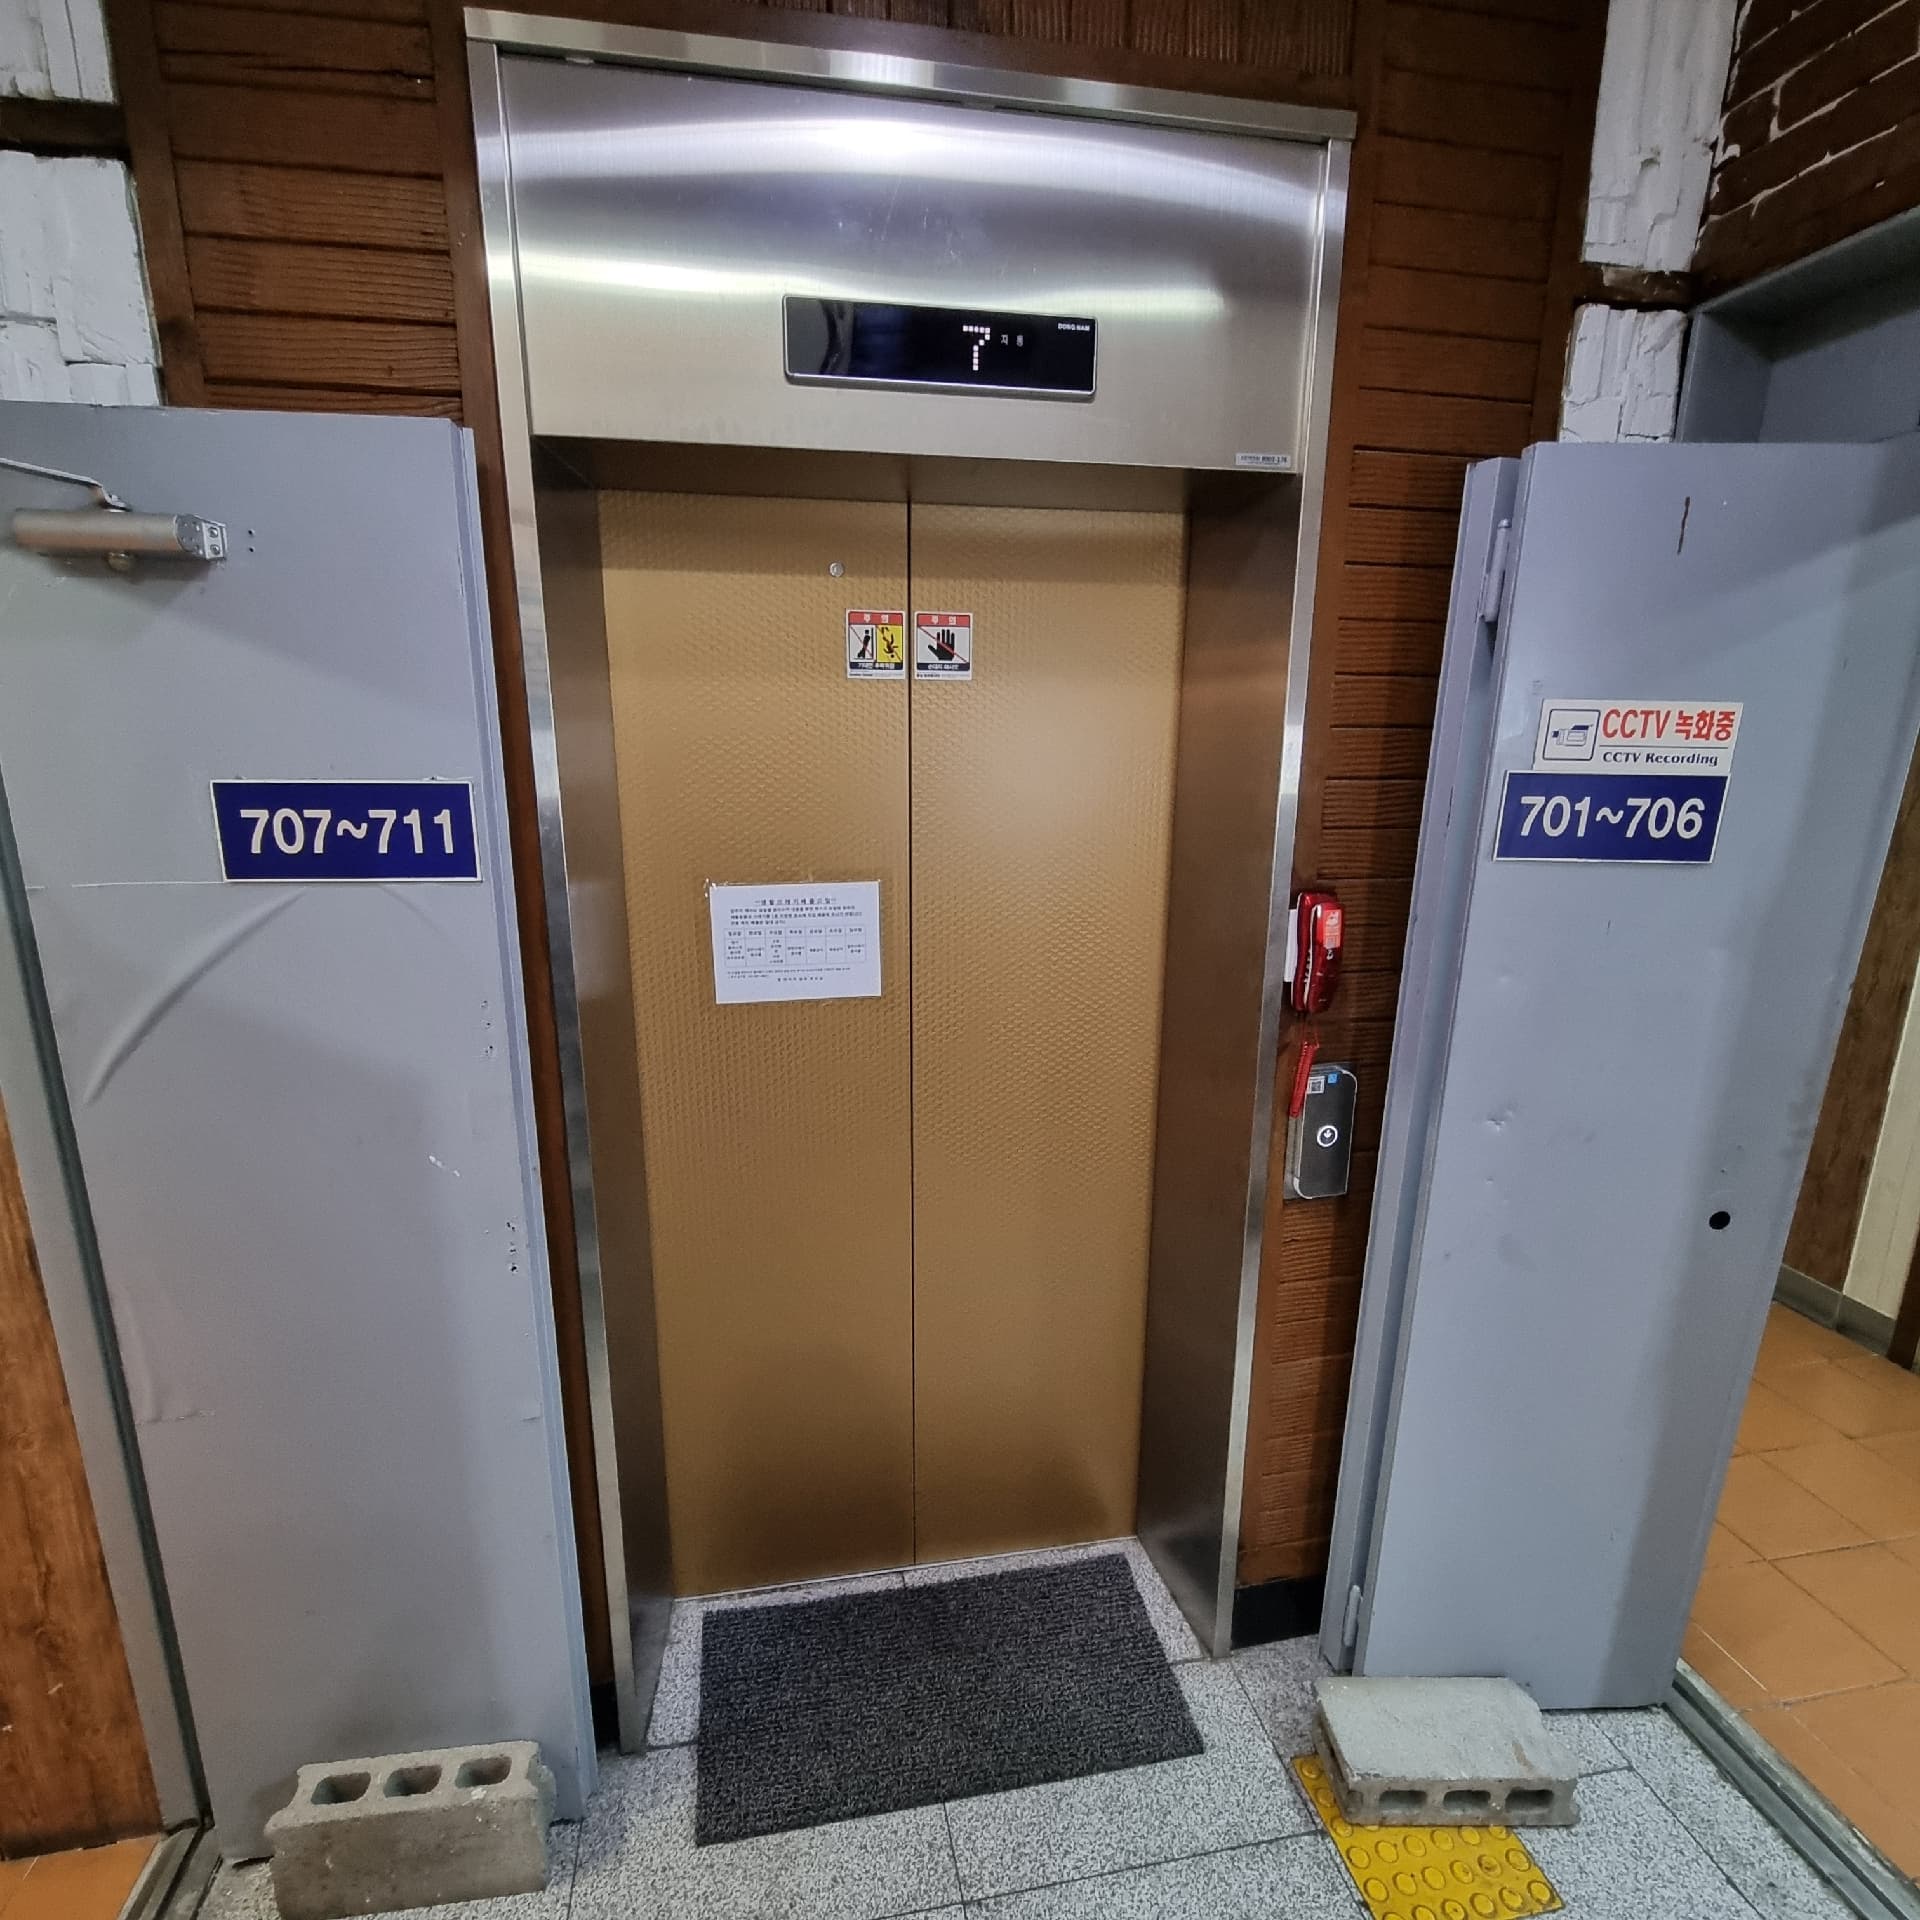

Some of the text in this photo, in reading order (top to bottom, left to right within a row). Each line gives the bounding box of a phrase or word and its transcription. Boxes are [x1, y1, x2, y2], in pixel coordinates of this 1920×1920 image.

[1057, 322, 1091, 332] DONG NAM
[962, 324, 991, 372] 7
[1602, 708, 1736, 742] CCTV 녹화중
[1603, 751, 1719, 767] CCTV Recording
[239, 807, 455, 855] 707~711
[1519, 795, 1706, 840] 701~706
